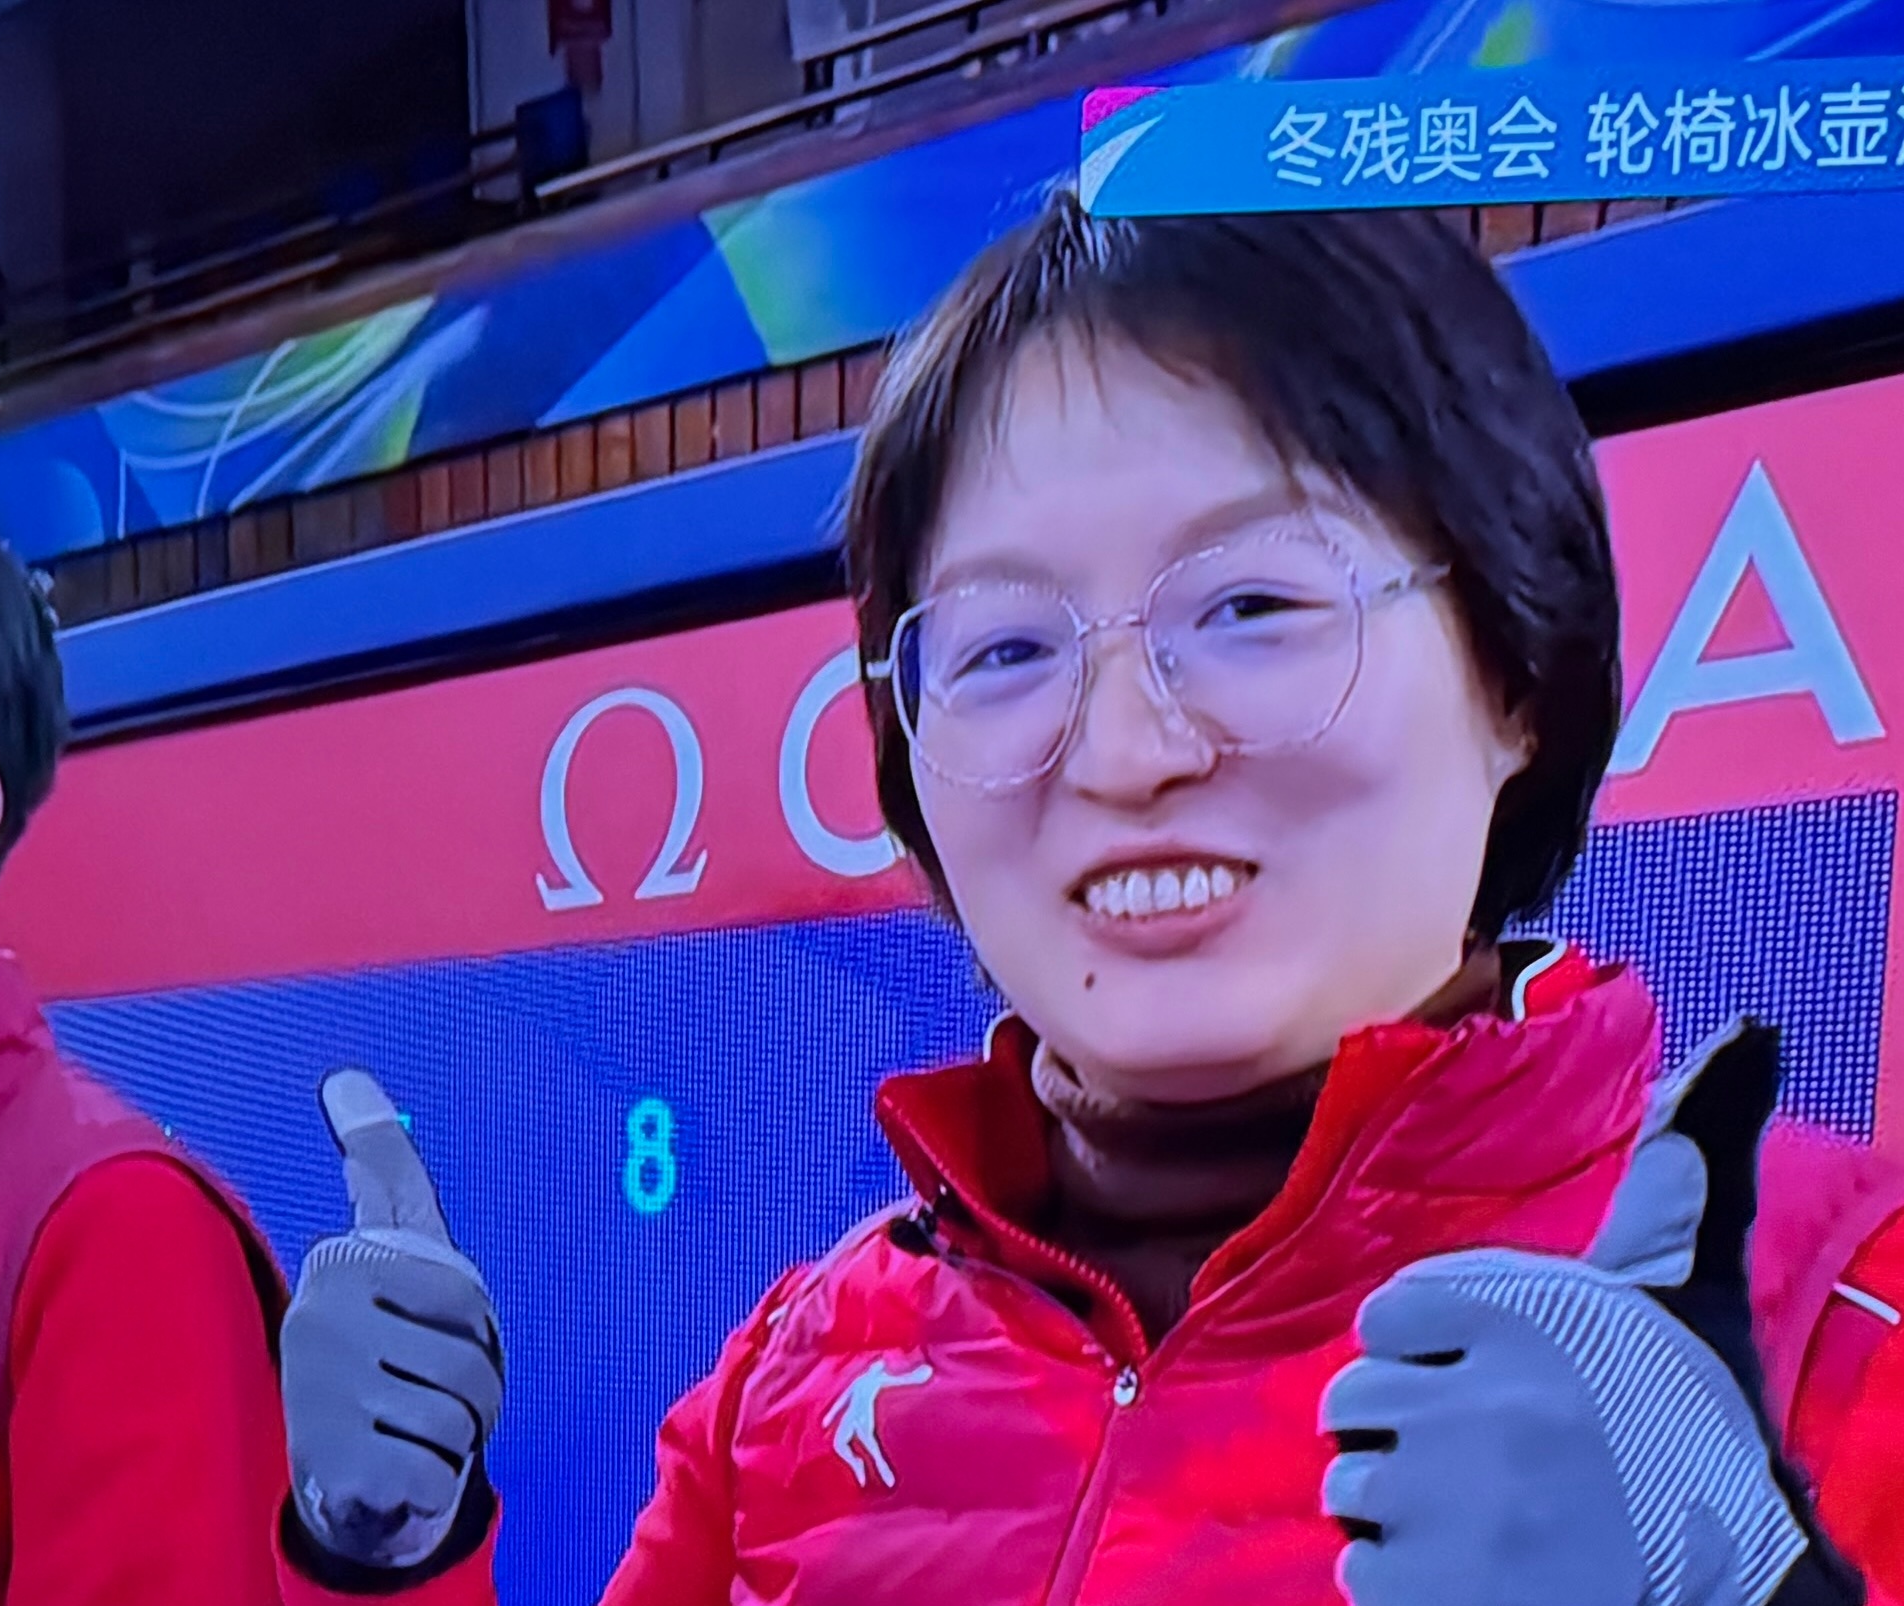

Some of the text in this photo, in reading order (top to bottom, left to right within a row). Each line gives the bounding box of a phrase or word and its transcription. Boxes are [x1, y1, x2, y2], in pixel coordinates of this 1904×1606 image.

[1267, 93, 1559, 189] 冬残奥会
[624, 1096, 678, 1215] 8
